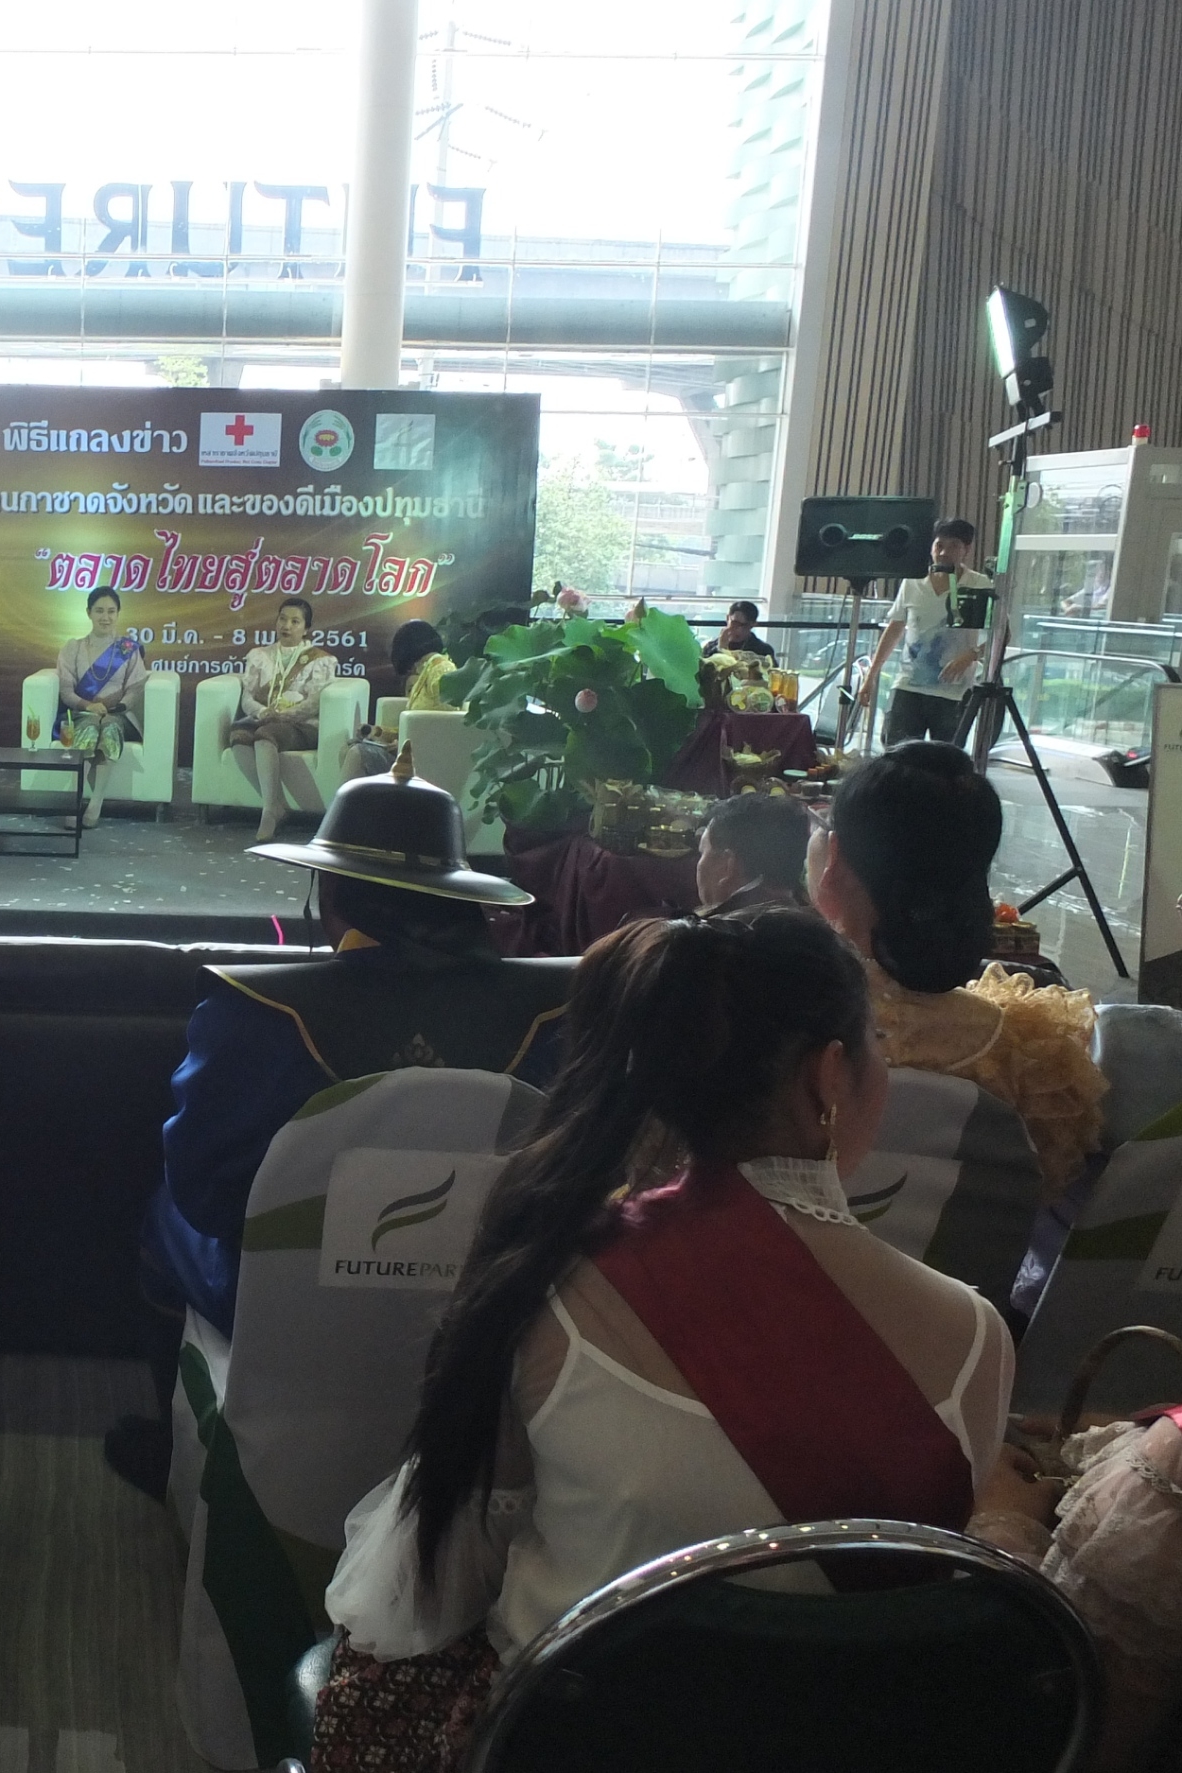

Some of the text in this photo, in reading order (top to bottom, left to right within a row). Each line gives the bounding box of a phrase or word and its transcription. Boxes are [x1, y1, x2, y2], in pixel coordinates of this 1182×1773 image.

[3, 420, 188, 453] พิธีแถลงข่าว
[197, 484, 486, 526] และของดีเมืองปทุมธานี
[126, 627, 154, 644] 30
[232, 628, 247, 645] 8
[312, 629, 368, 648] 2561
[335, 1260, 463, 1278] FUTUREPAR
